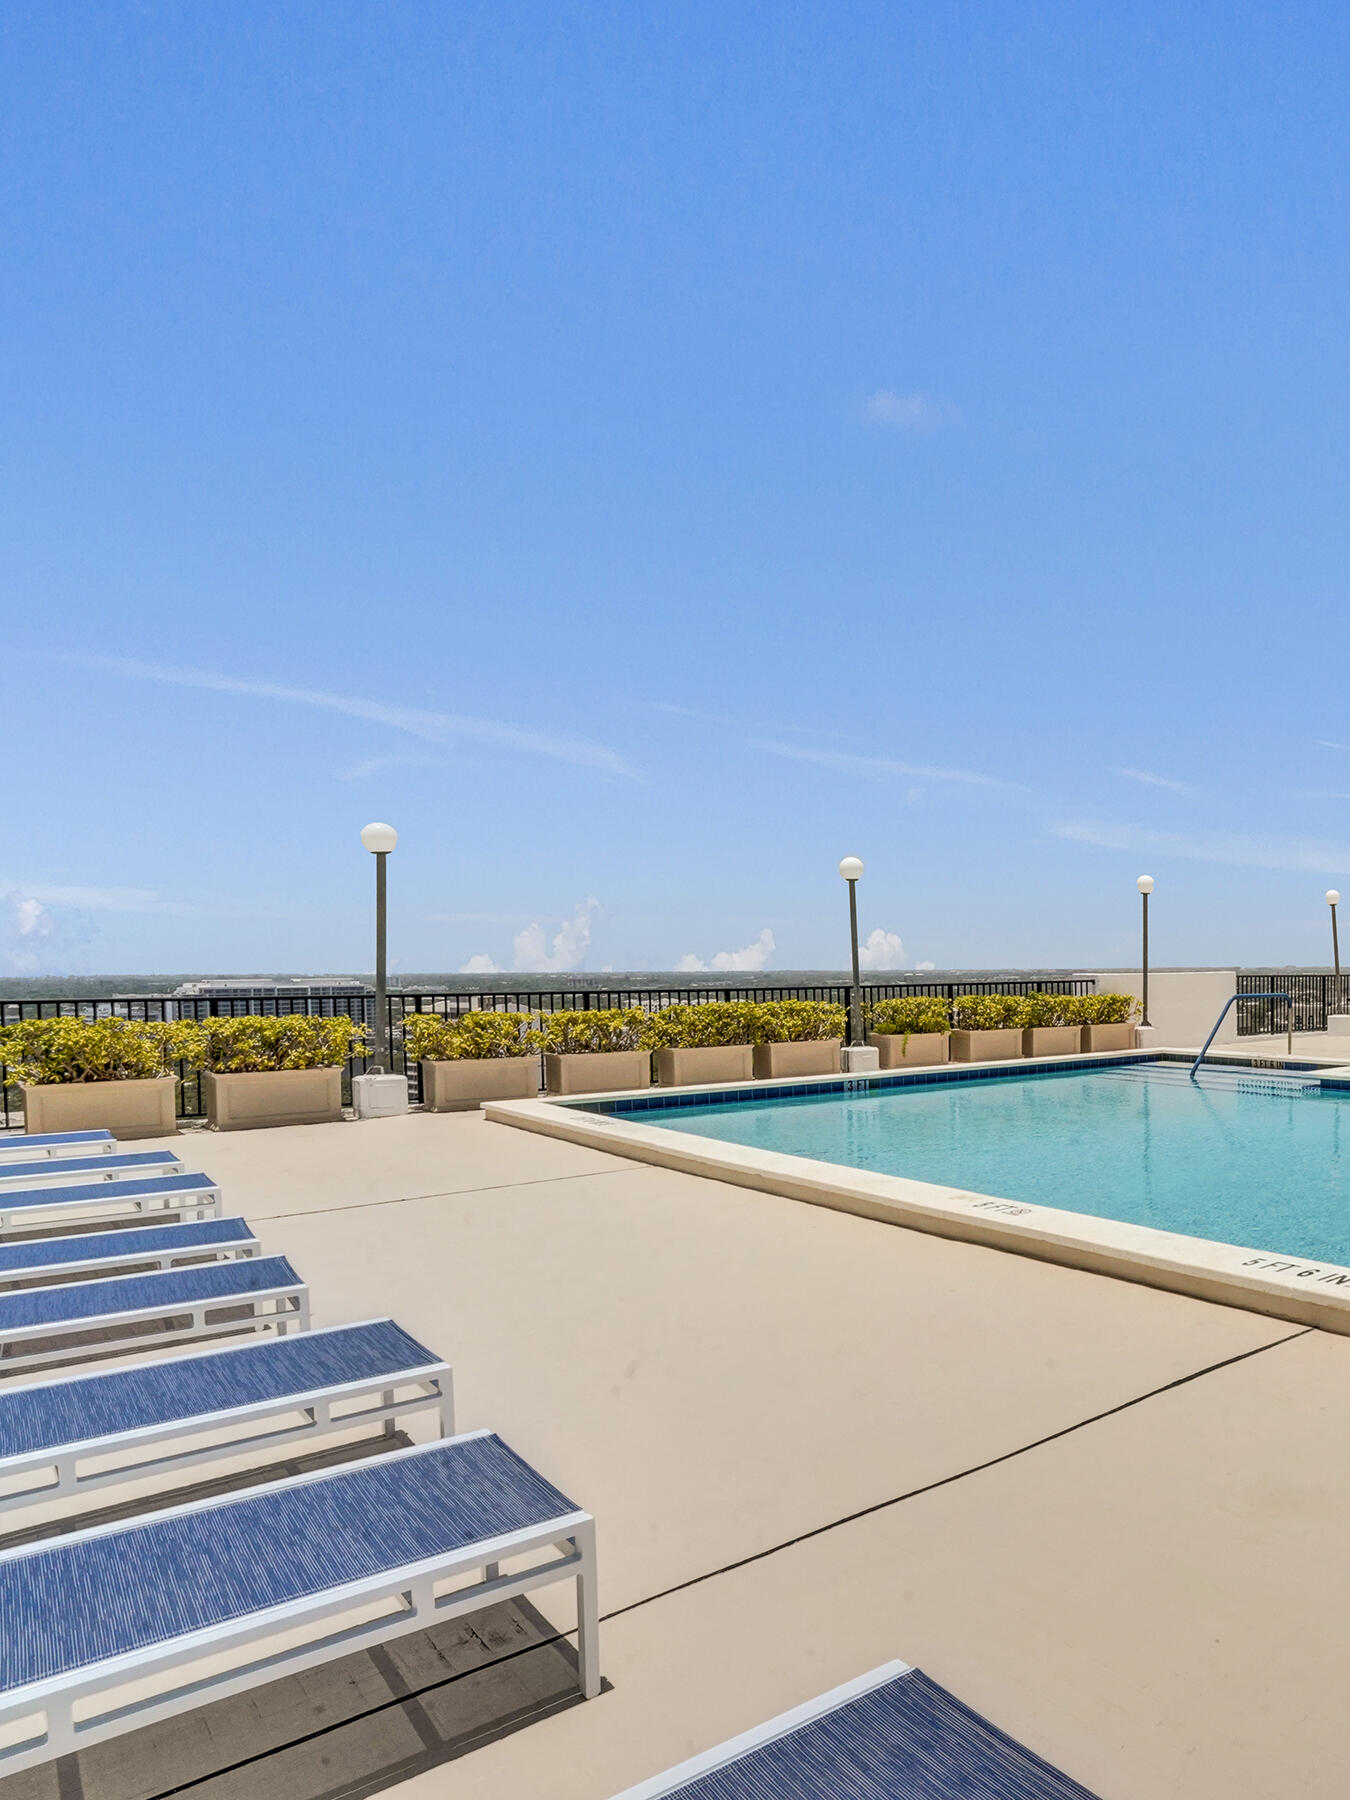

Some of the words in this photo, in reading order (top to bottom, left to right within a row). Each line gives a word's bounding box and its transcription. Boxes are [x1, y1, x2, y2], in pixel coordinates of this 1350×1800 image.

[848, 1080, 853, 1090] 3
[1241, 1258, 1267, 1266] 5
[1259, 1261, 1302, 1273] FT
[1296, 1268, 1321, 1277] 6
